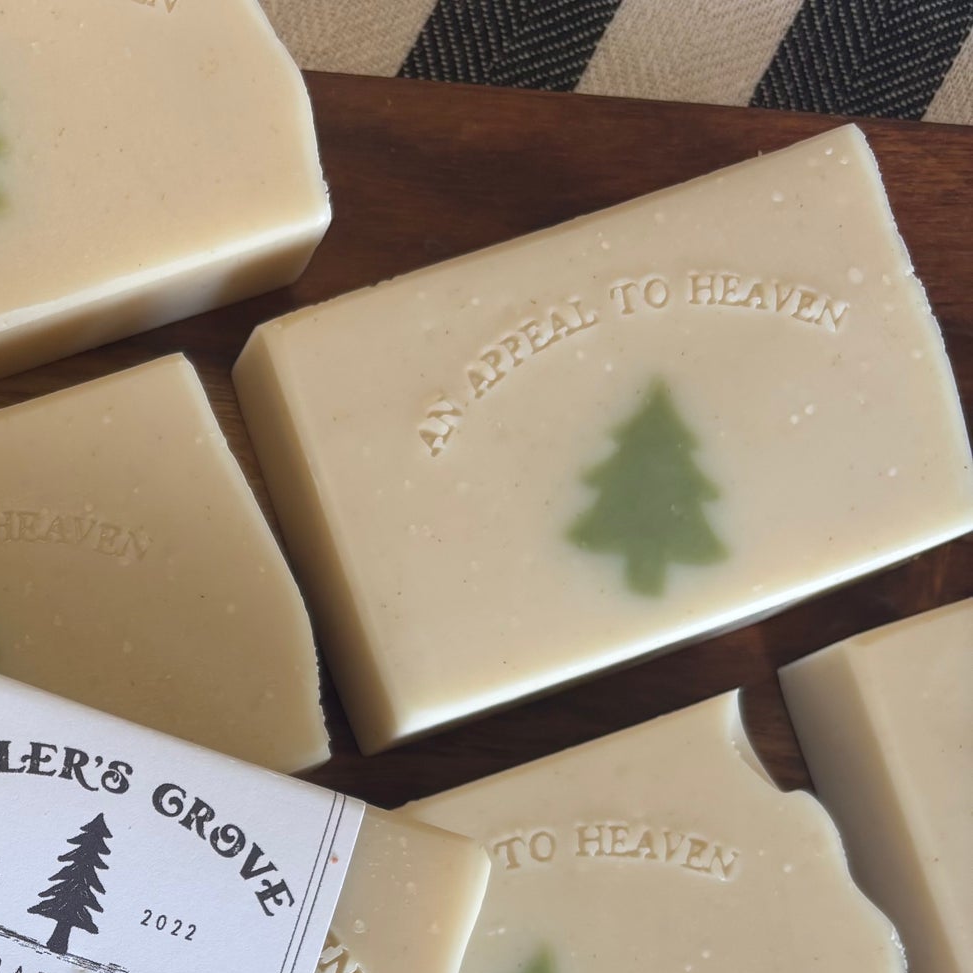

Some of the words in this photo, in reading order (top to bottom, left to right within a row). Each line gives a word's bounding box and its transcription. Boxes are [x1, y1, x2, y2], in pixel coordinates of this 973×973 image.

[418, 394, 463, 457] AN
[465, 298, 600, 398] APPEAL
[609, 277, 669, 316] TO
[688, 271, 850, 332] HEAVEN
[151, 782, 295, 918] GROVE
[493, 830, 557, 871] TO
[575, 823, 740, 880] HEAVEN
[140, 909, 198, 941] 2022
